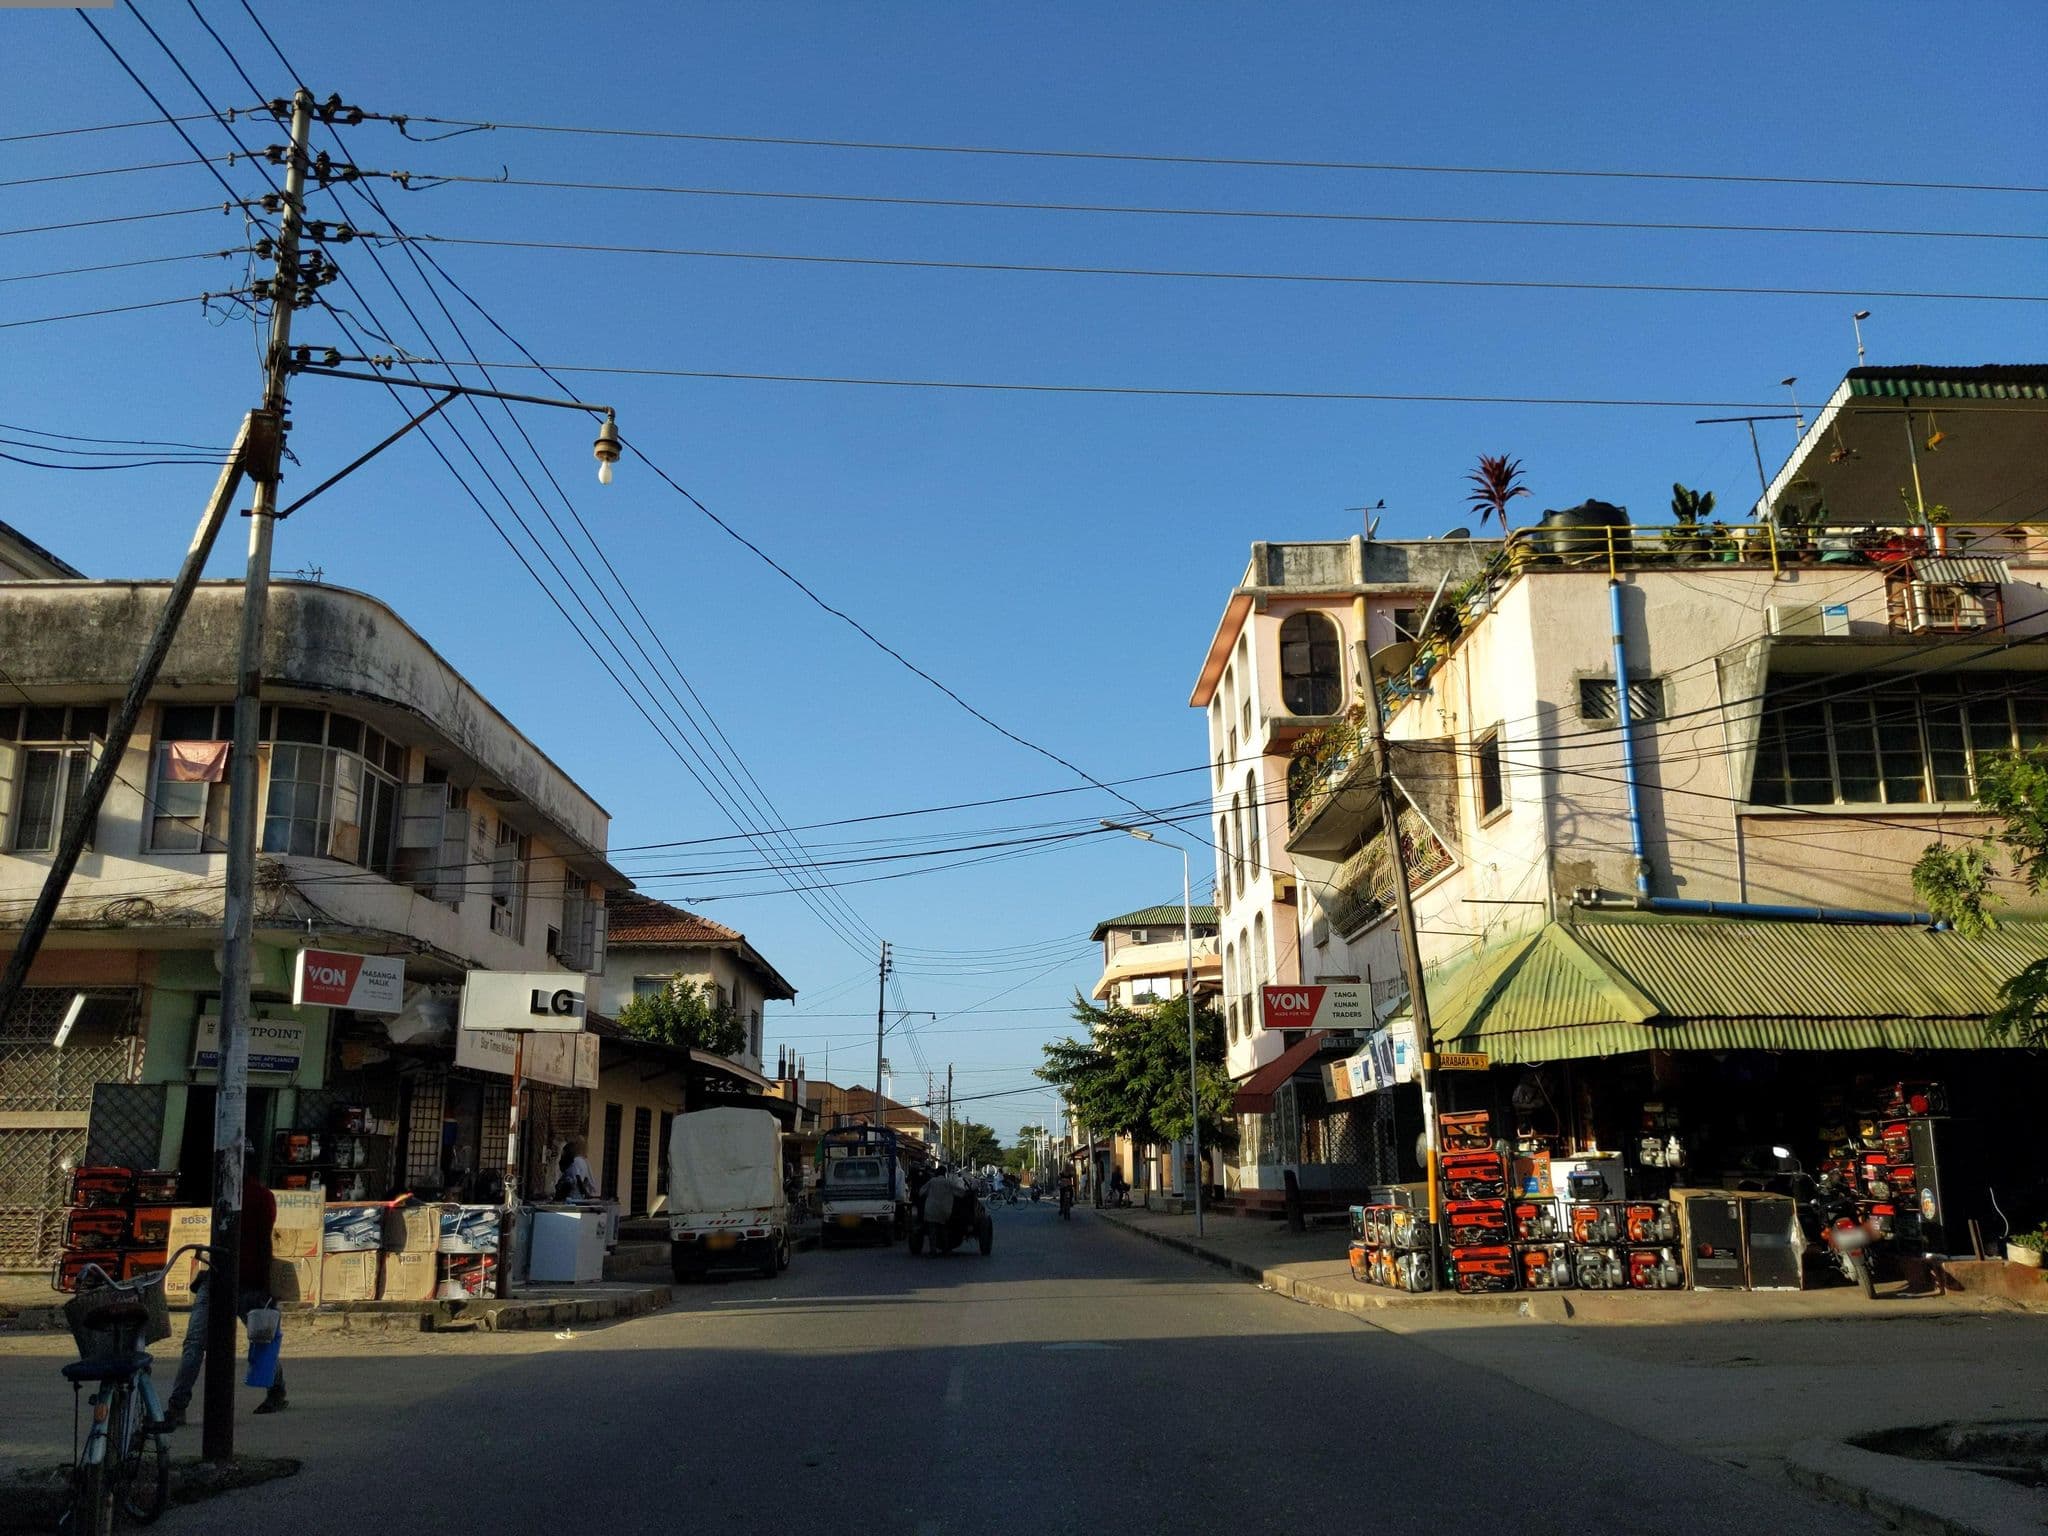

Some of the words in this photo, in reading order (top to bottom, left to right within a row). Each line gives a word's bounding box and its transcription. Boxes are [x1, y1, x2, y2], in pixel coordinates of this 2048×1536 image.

[306, 965, 347, 986] VON
[362, 969, 397, 980] MASANGA
[368, 979, 390, 987] MALIK
[530, 989, 574, 1015] LG
[1266, 993, 1310, 1010] VON
[250, 1026, 302, 1039] TPOINT
[275, 1192, 321, 1210] ONERY
[181, 1216, 208, 1225] BOSS
